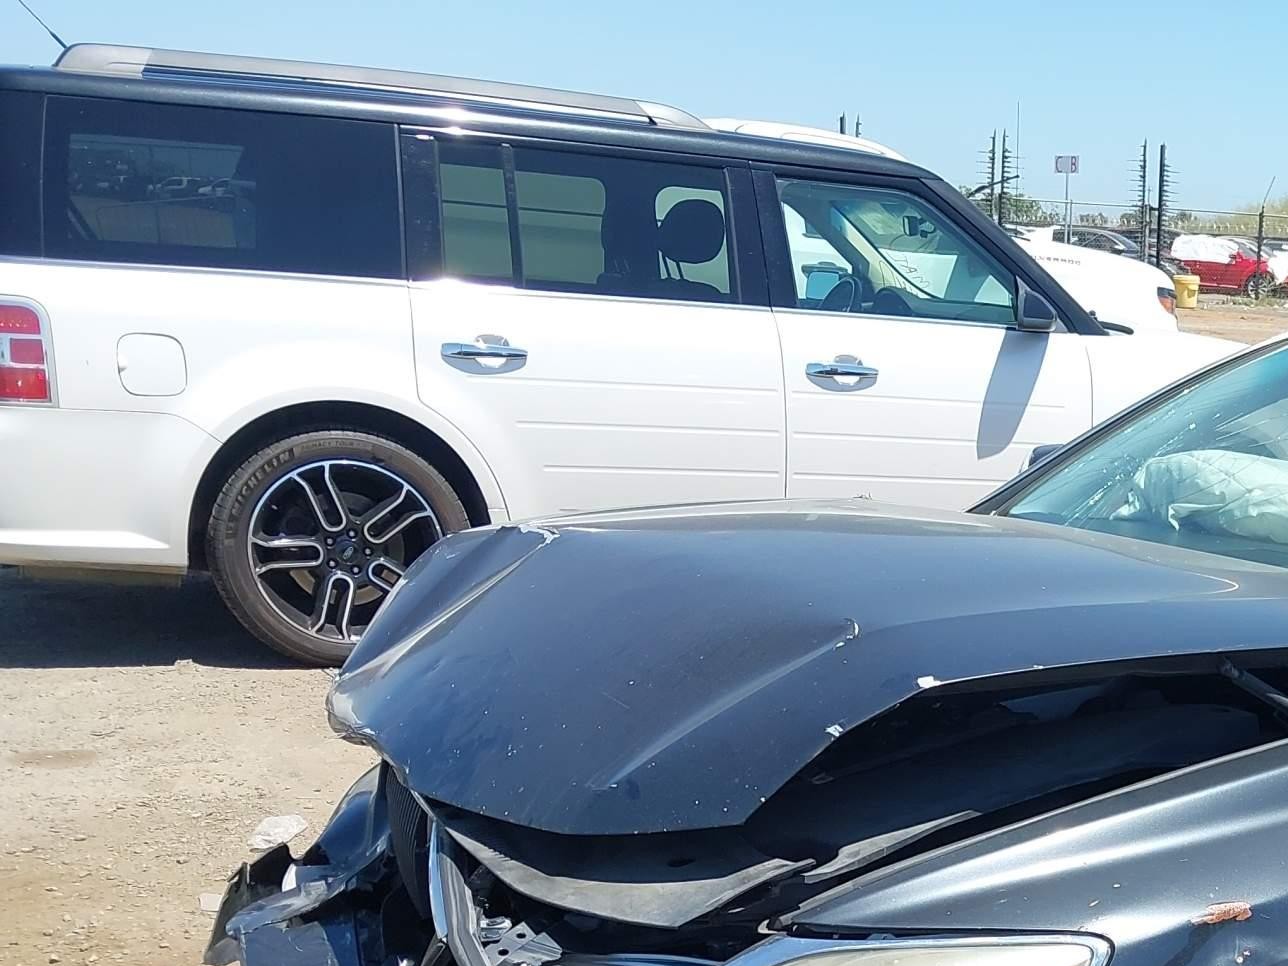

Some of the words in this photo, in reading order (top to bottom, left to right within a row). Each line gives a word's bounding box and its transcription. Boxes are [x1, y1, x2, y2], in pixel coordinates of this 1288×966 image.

[1055, 155, 1063, 173] C
[1070, 155, 1077, 173] B
[231, 449, 293, 515] MICHELIN
